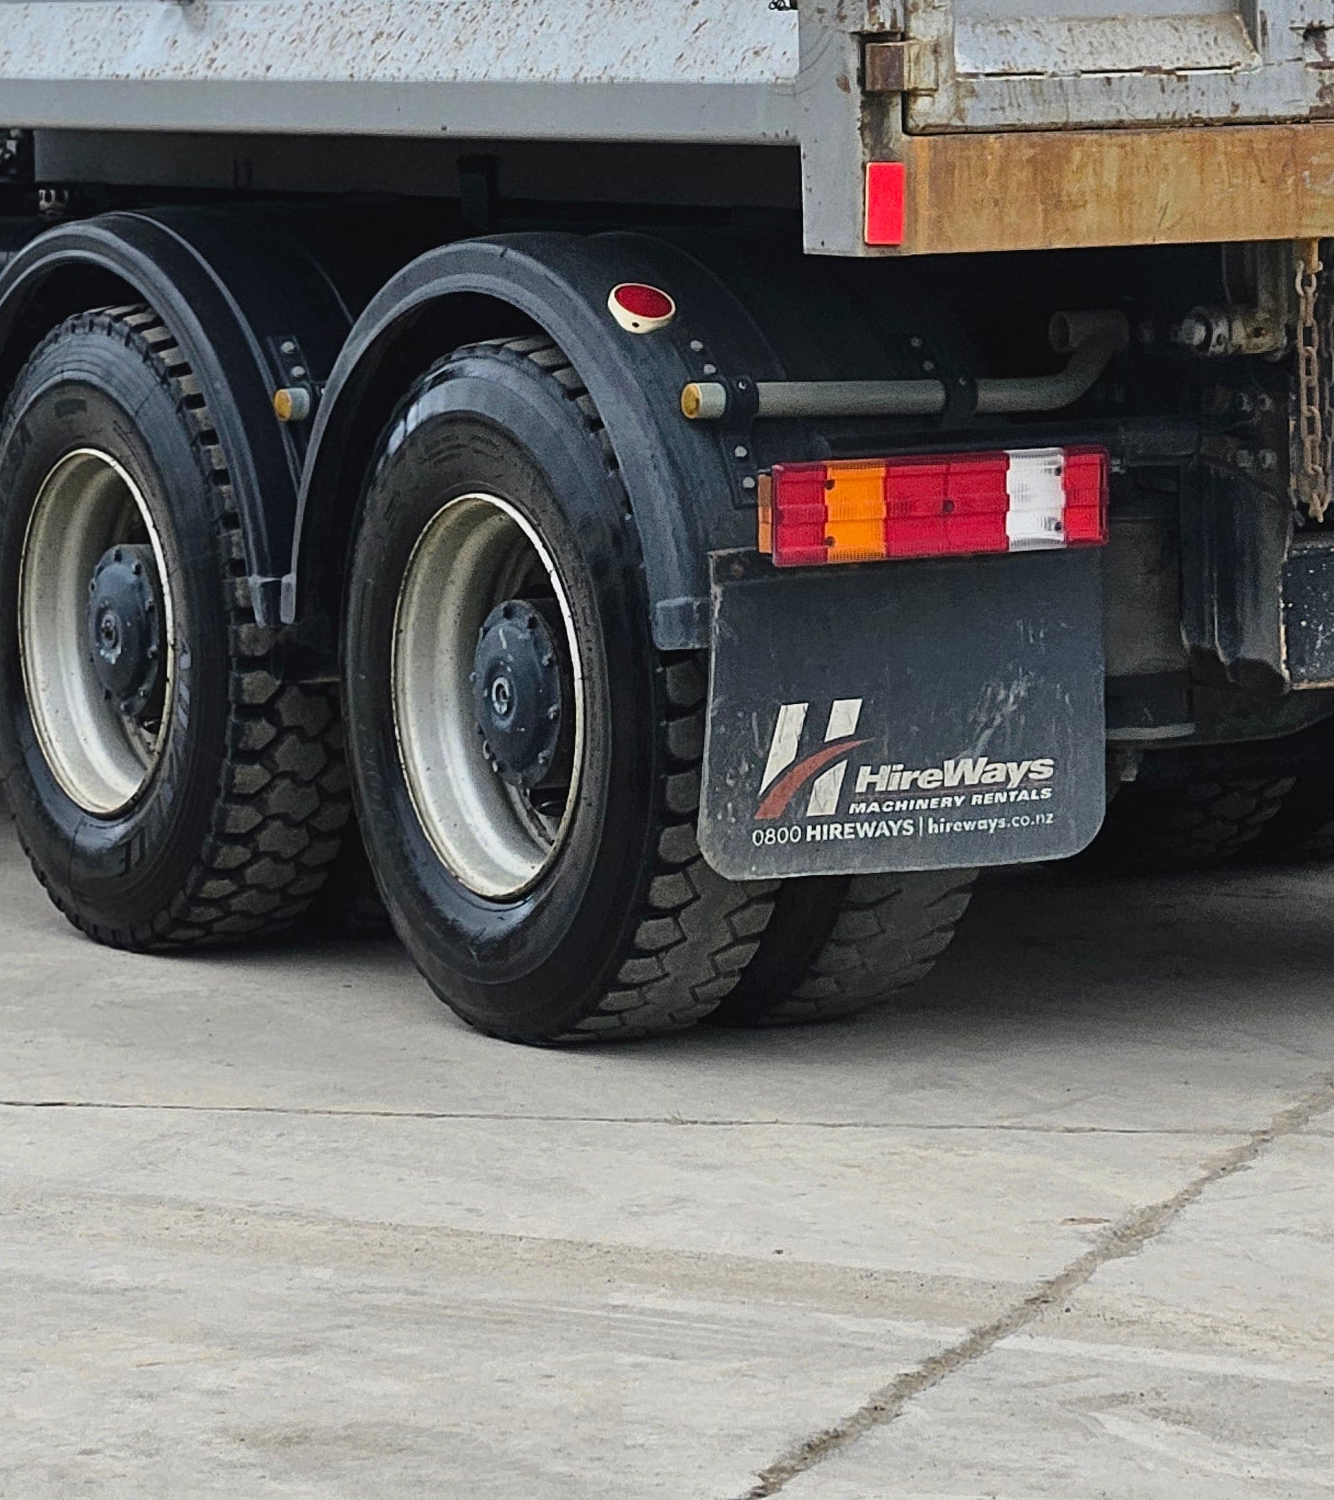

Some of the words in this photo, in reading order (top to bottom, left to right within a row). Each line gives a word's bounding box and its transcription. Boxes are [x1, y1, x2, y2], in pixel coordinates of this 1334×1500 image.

[855, 756, 1055, 794] HireWays
[849, 794, 966, 815] MACHINERY
[970, 787, 1053, 806] RENTALS
[751, 824, 803, 846] 0800
[805, 818, 915, 843] HIREWAYS
[927, 811, 1055, 836] hireways.co.nz
